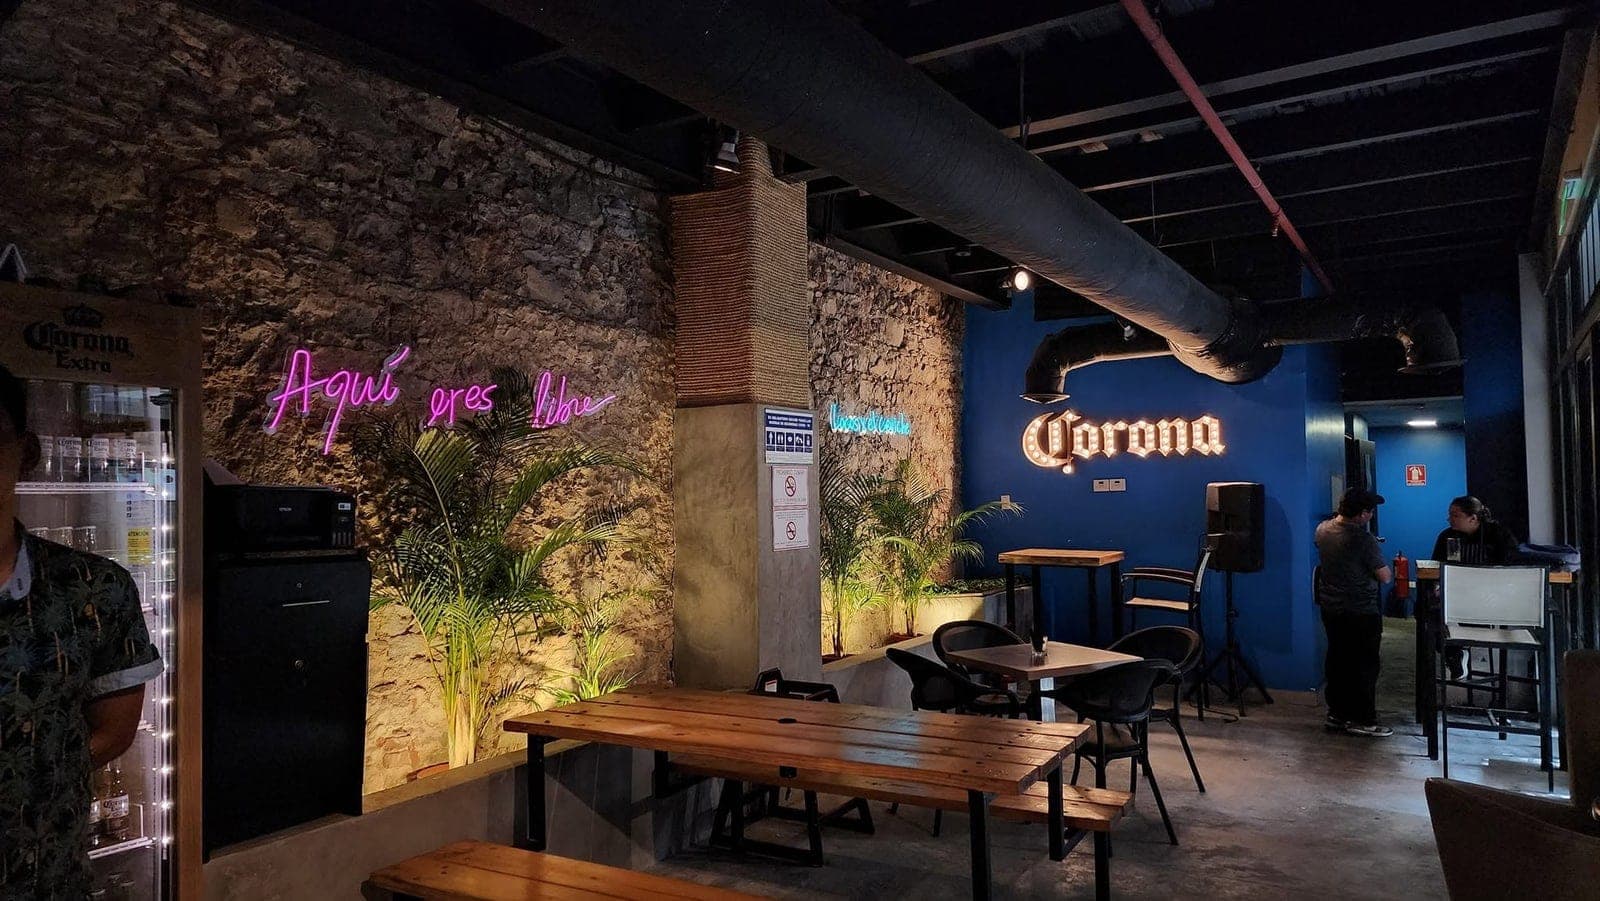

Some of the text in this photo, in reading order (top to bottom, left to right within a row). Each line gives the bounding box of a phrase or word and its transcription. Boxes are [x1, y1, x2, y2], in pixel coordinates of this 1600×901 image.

[23, 322, 134, 358] Corona
[56, 349, 111, 373] Extra
[268, 347, 616, 456] Aquí eres libre
[1022, 409, 1226, 474] Corona
